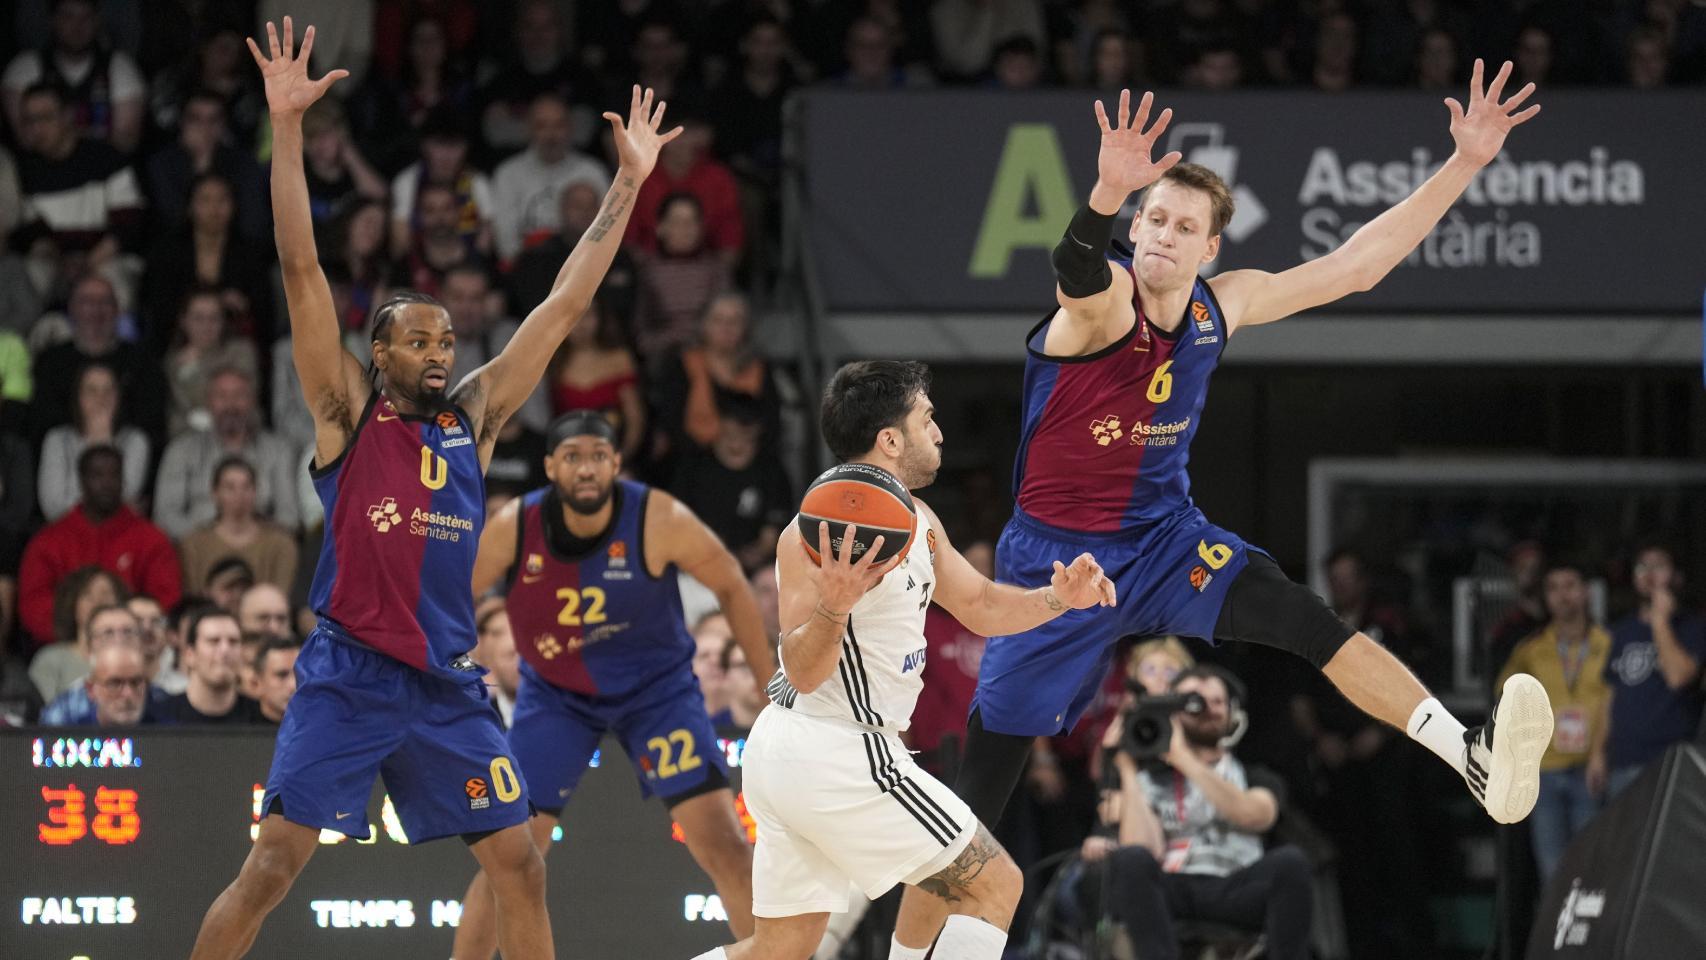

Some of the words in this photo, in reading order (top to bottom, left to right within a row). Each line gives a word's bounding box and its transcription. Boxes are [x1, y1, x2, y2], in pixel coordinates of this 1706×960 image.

[1299, 147, 1645, 205] Assitència
[969, 123, 1080, 277] A
[1301, 206, 1542, 268] Stària
[1146, 360, 1174, 403] 6
[1129, 434, 1177, 446] Sanitària
[409, 520, 459, 542] Sanitària
[1198, 539, 1233, 570] 6
[556, 586, 607, 626] 22
[33, 738, 142, 767] LOCAL
[647, 729, 703, 779] 22
[489, 756, 521, 803] 0
[38, 784, 140, 844] 38
[22, 897, 136, 924] FALTES
[311, 900, 415, 927] TEMPS
